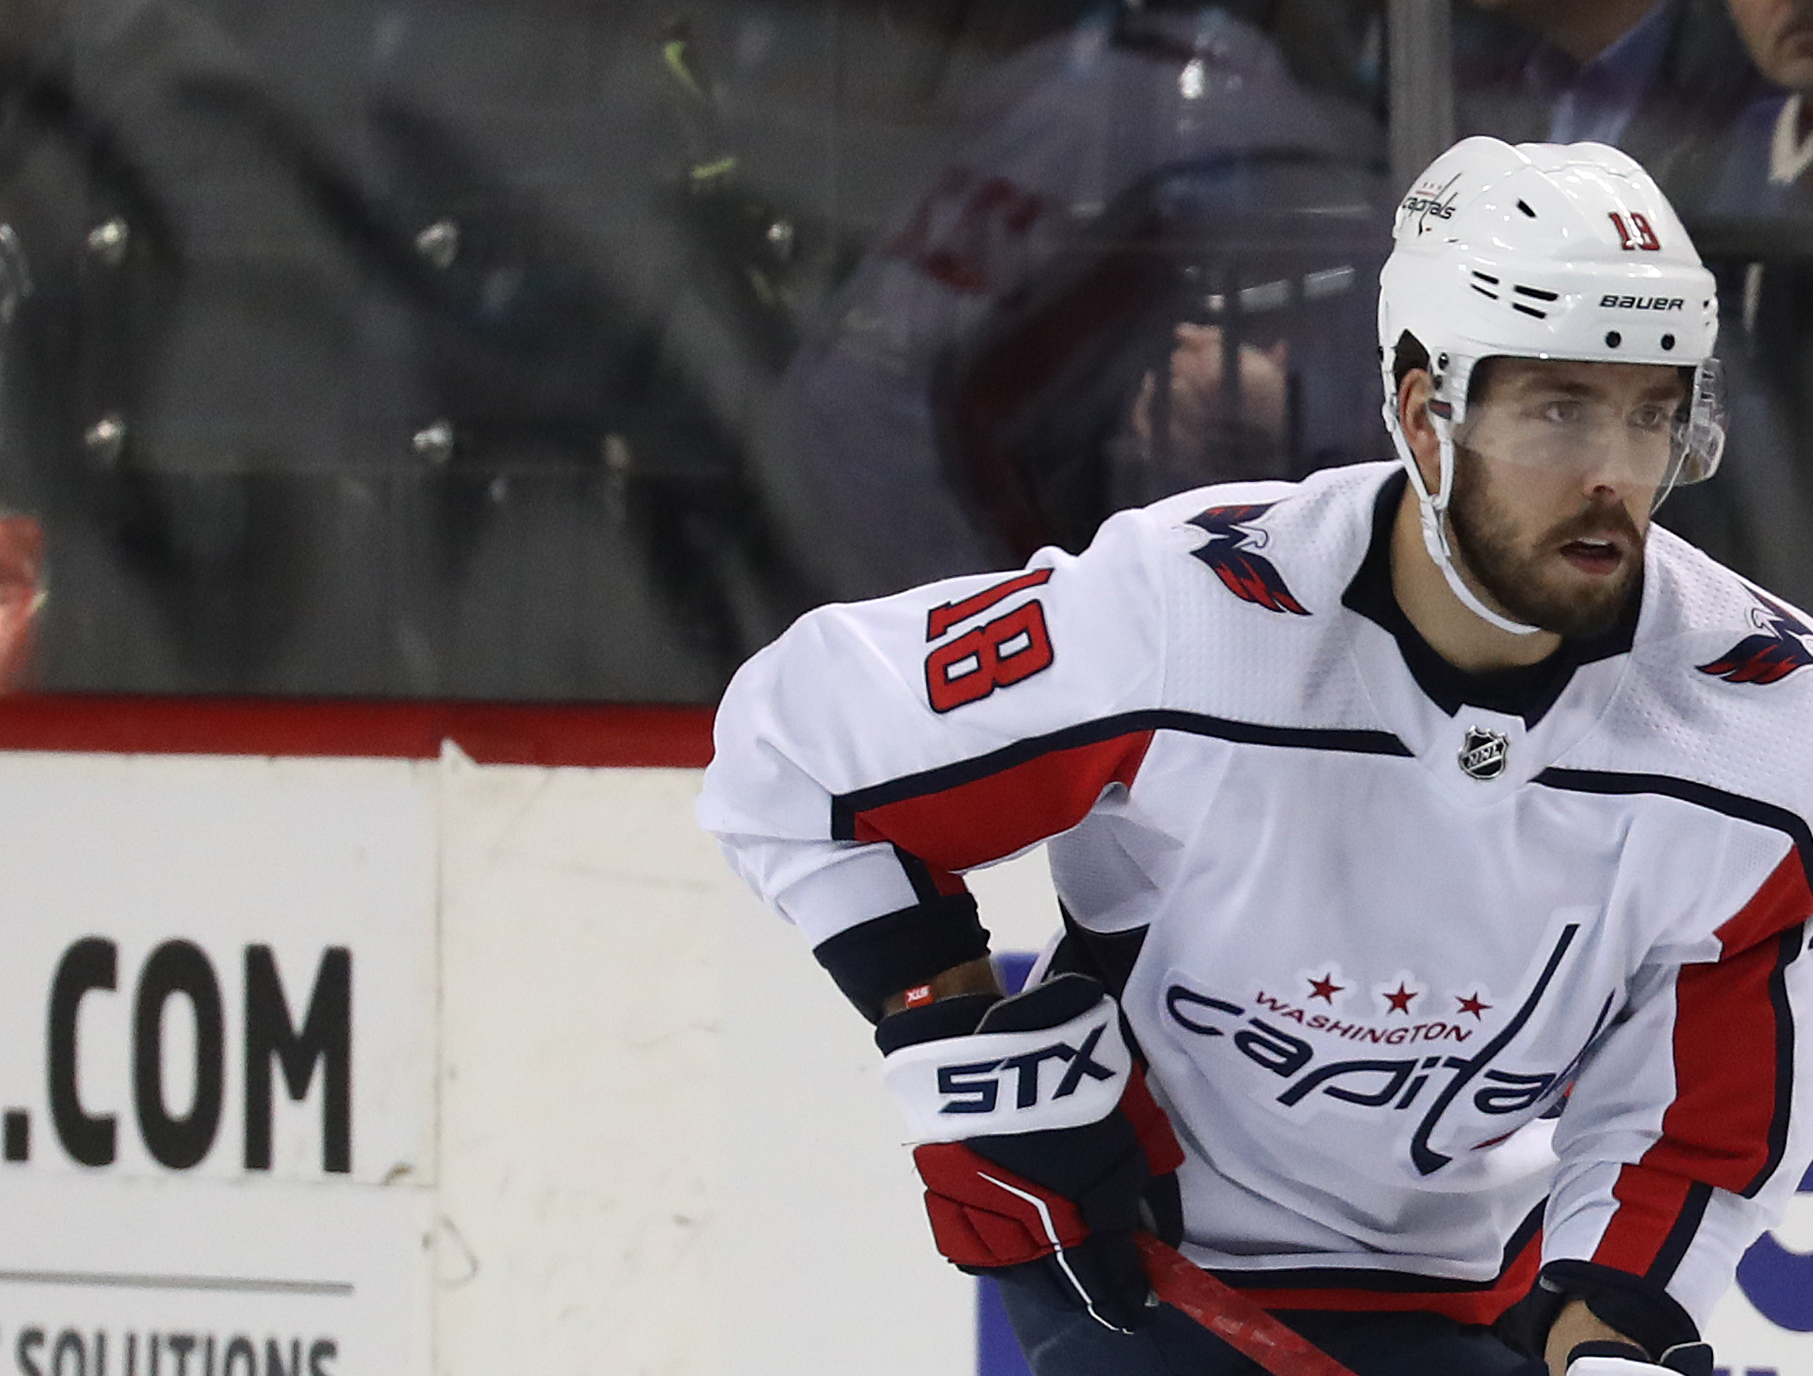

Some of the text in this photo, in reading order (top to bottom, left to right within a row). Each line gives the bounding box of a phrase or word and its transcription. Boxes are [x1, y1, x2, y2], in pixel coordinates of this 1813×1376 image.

[925, 567, 1054, 714] 18
[3, 935, 353, 1174] .COM
[936, 1022, 1117, 1115] STX
[1167, 924, 1615, 1175] capital
[1256, 991, 1473, 1045] WASHINGTON
